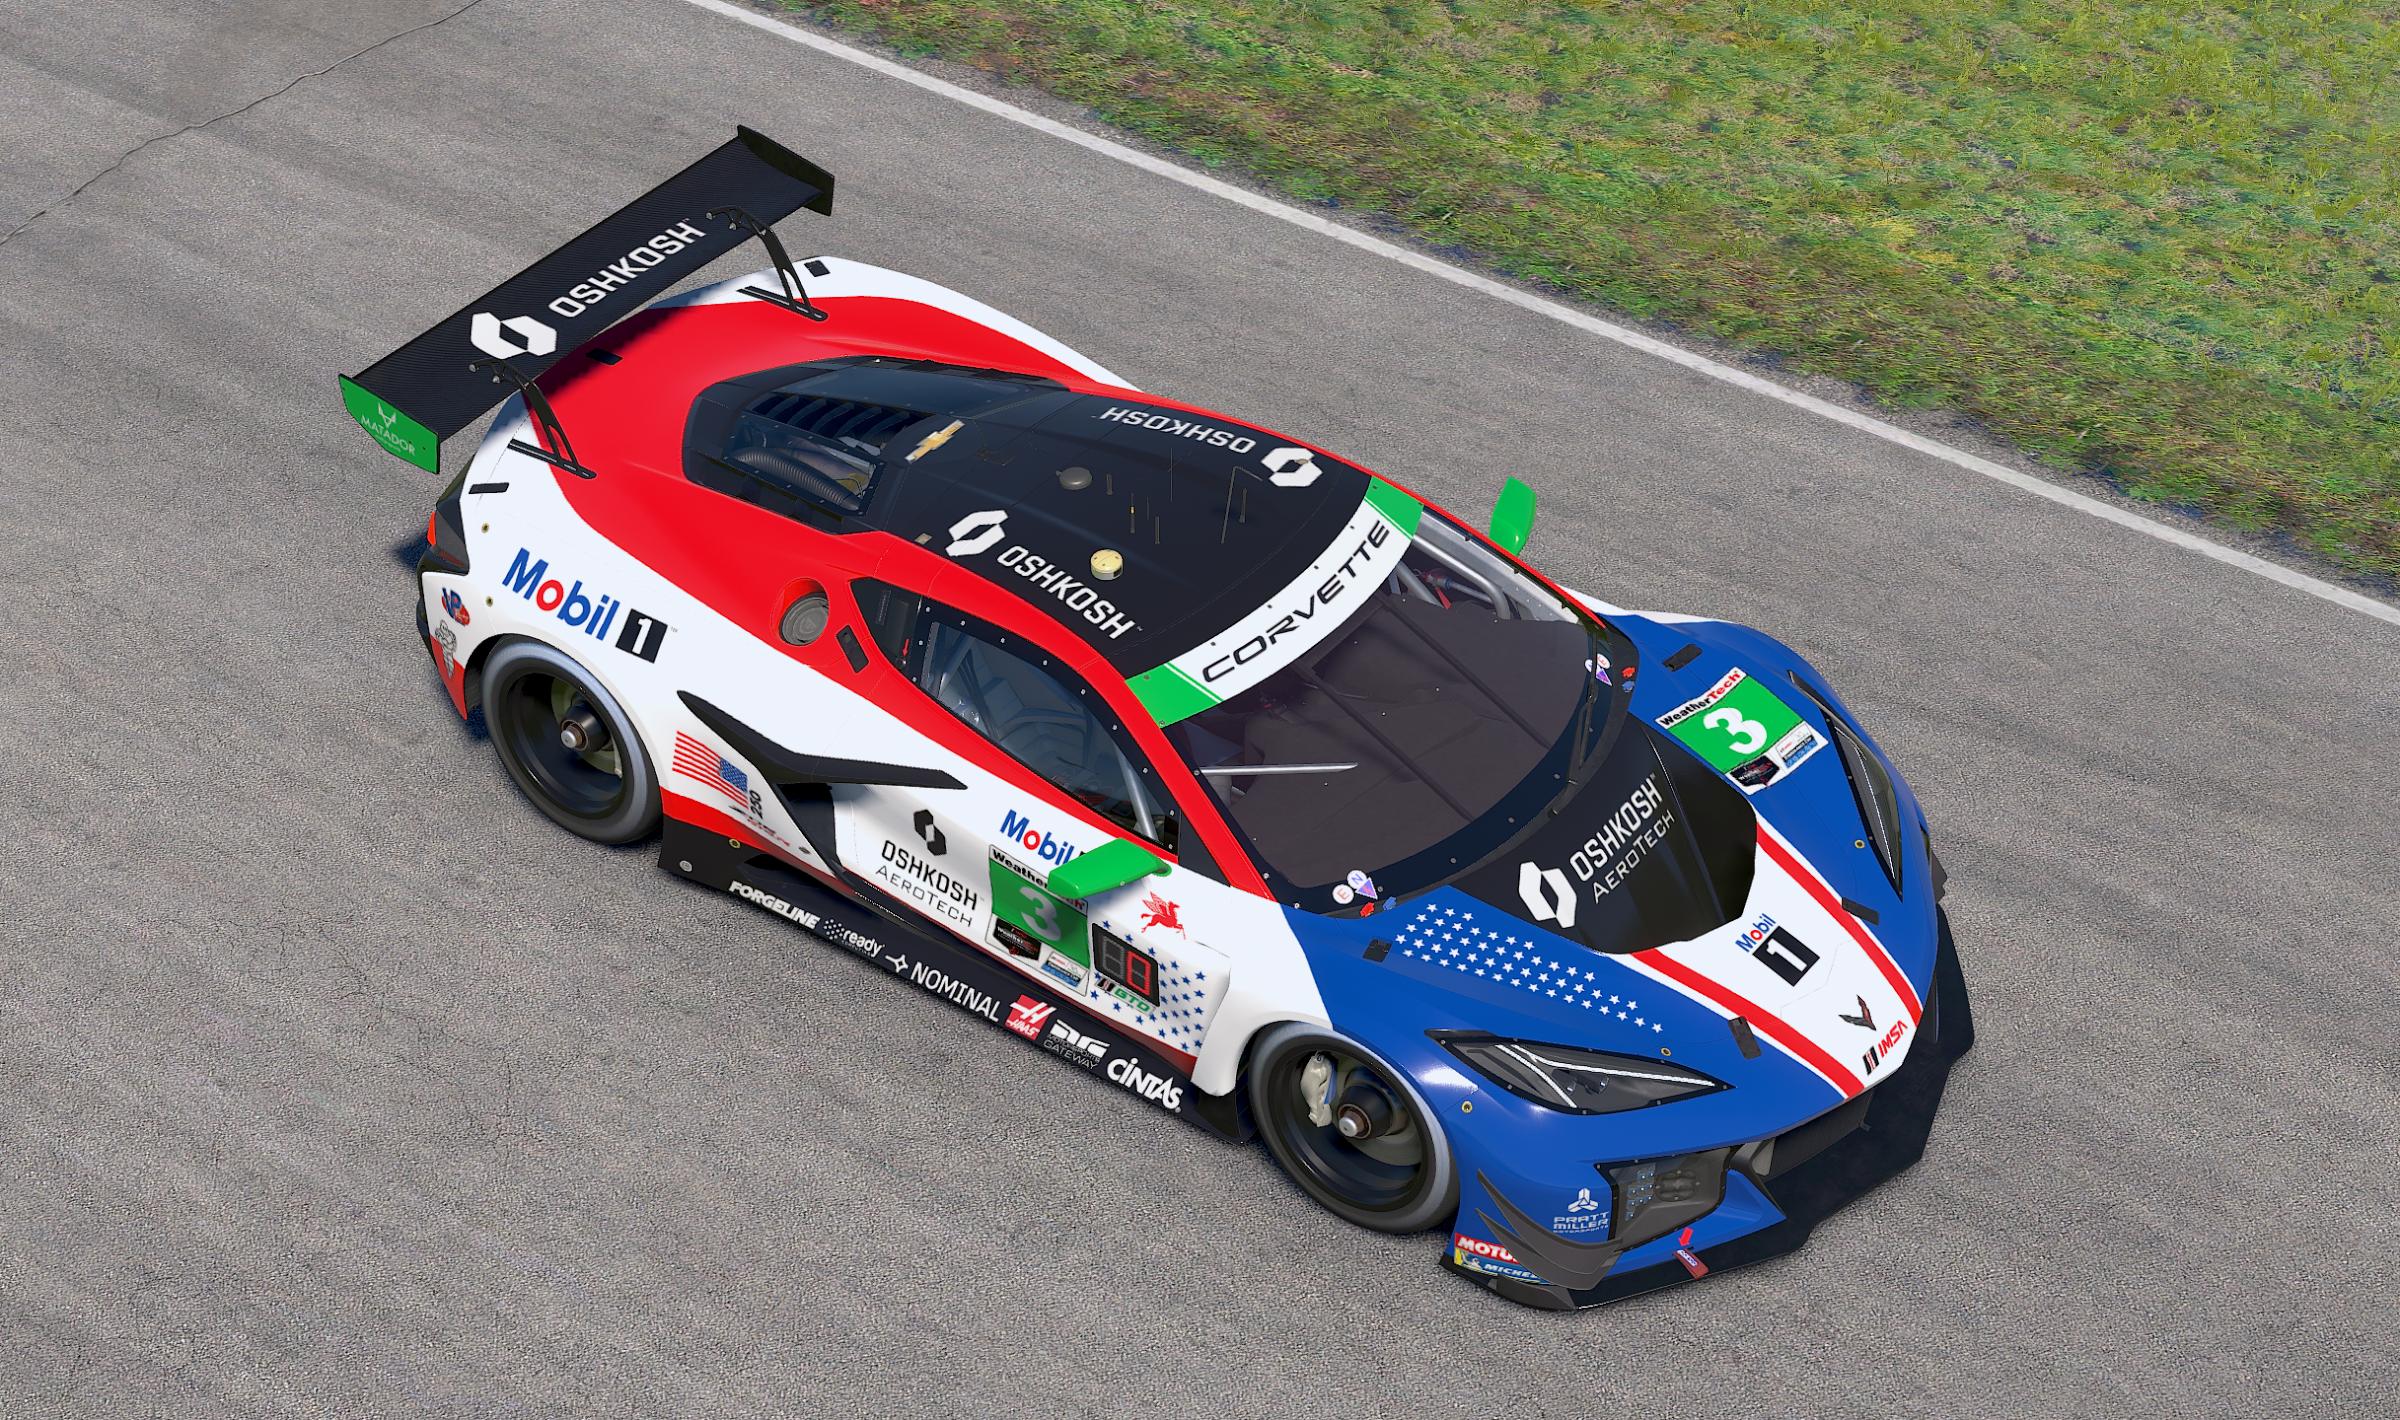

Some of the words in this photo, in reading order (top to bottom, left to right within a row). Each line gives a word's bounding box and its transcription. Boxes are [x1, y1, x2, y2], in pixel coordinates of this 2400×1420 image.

[548, 221, 706, 318] OSHKOSH
[361, 413, 416, 456] MATADOR
[1101, 407, 1257, 455] OSHKOSH
[502, 547, 621, 641] Mobil
[996, 544, 1137, 640] OSHKOSH
[1202, 519, 1392, 684] CORVETTE
[1660, 670, 1743, 727] WeatherTech
[1703, 707, 1768, 754] 3
[1000, 809, 1075, 866] Mobil
[1569, 778, 1664, 882] OSHKOSH
[875, 865, 973, 927] AEROTECH
[881, 840, 978, 911] OSHKOSH
[729, 880, 821, 930] FORGELINE
[1020, 886, 1061, 941] 3
[843, 930, 883, 958] ready
[1735, 913, 1778, 953] Mobil
[910, 962, 1002, 1023] NOMINAL
[1114, 987, 1150, 1012] GTD
[1043, 1039, 1099, 1069] GATEWAY
[1878, 1019, 1909, 1059] IMSA
[1553, 1211, 1610, 1223] PRATT
[1553, 1218, 1609, 1230] MILLER
[1457, 1236, 1519, 1263] MOTU
